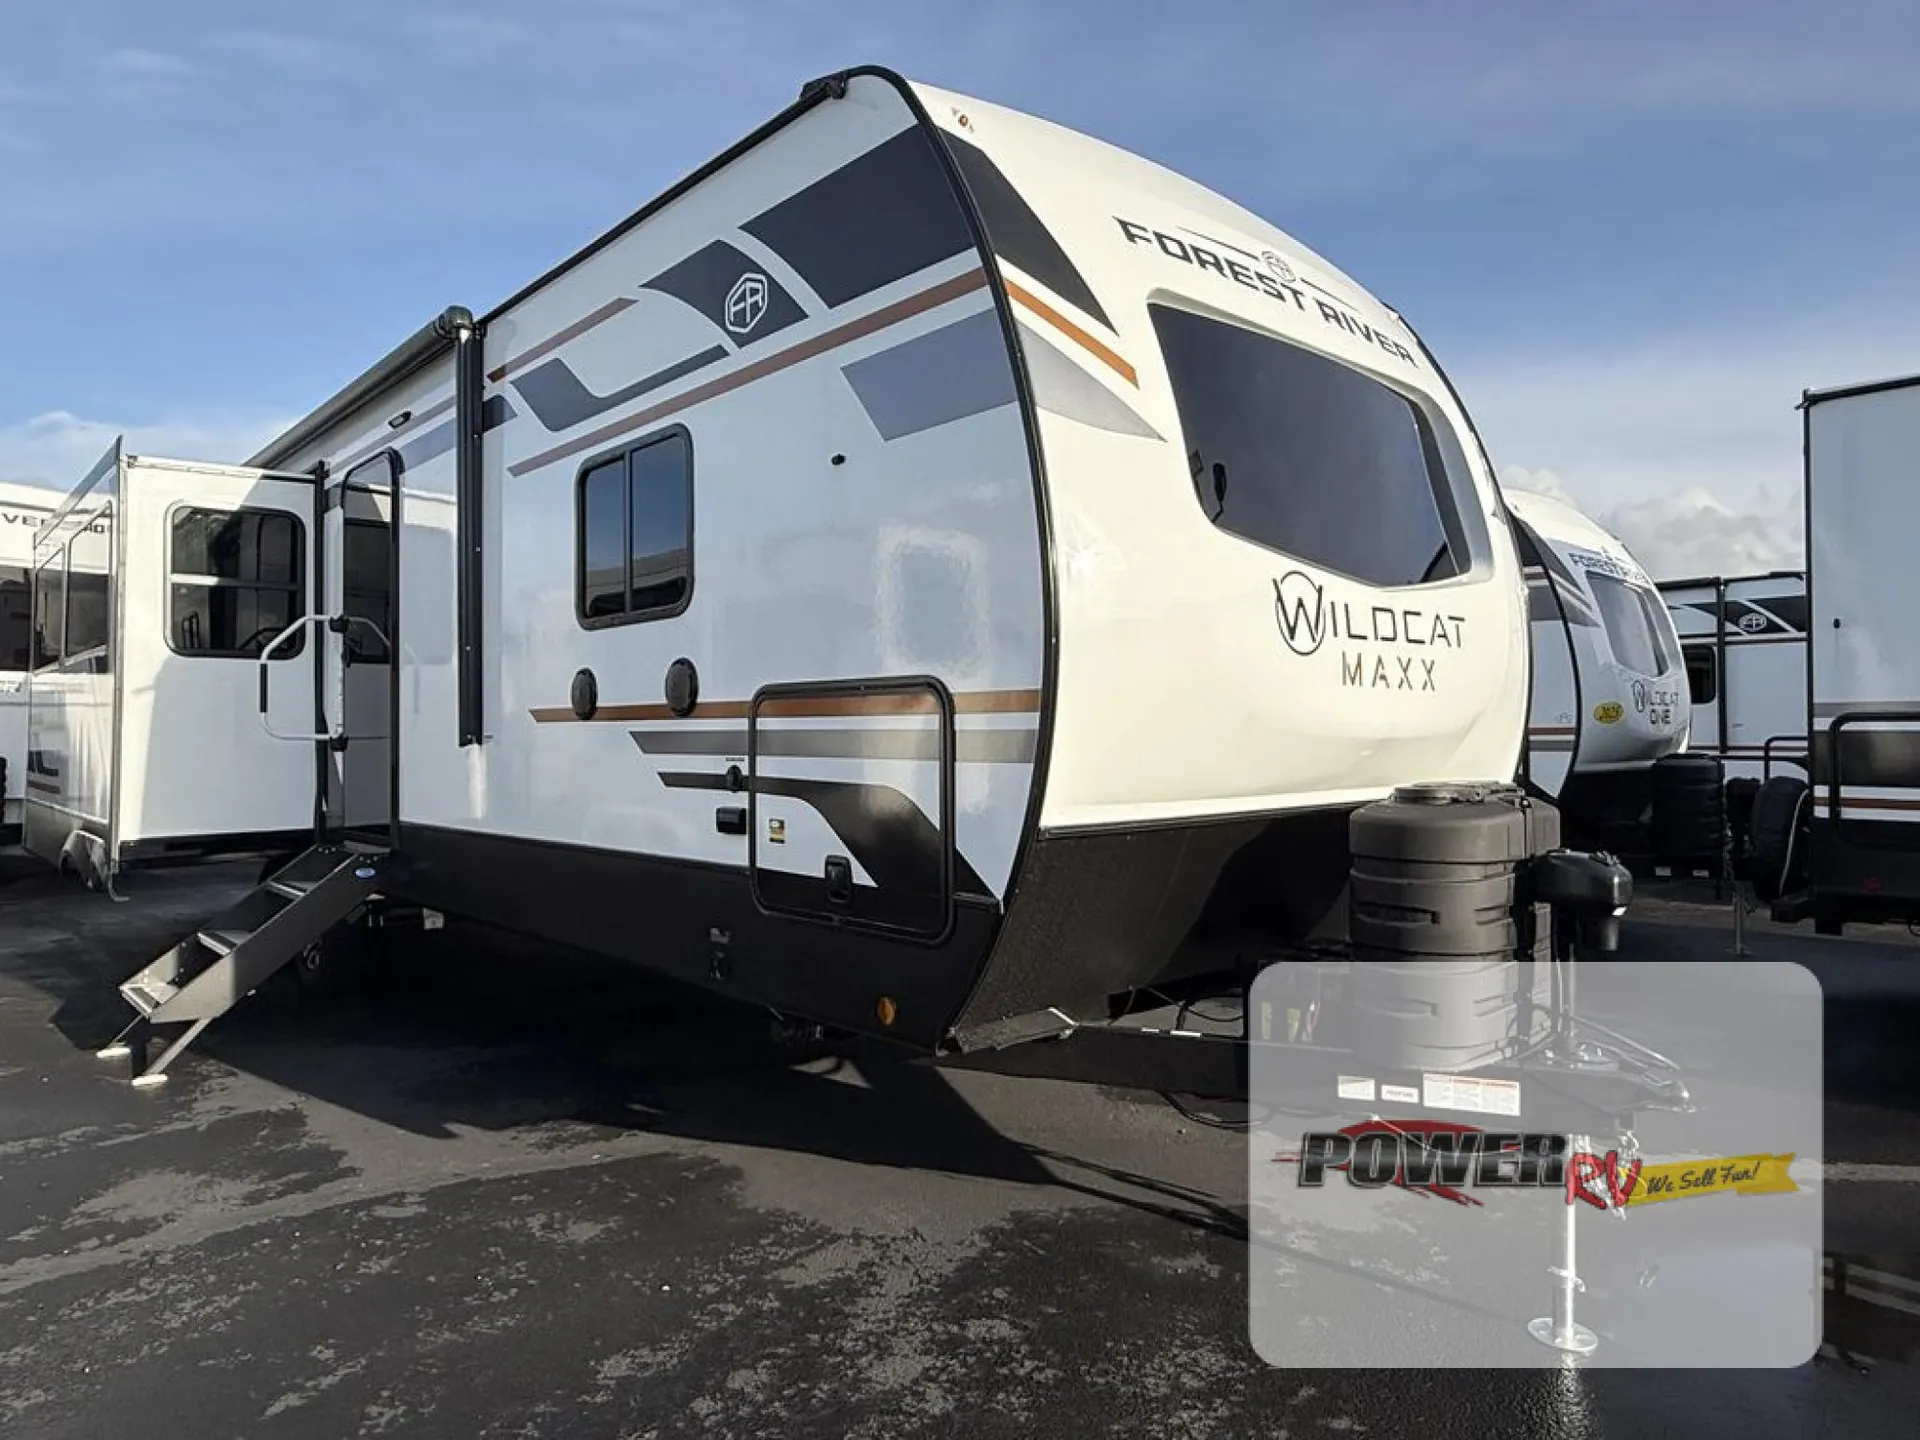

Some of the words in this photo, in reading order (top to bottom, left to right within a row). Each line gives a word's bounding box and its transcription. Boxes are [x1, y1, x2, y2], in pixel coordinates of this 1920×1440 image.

[1111, 214, 1306, 312] FOREST
[1315, 298, 1421, 368] RIVER
[1272, 570, 1466, 657] WILDCAT
[1341, 650, 1436, 692] MAXX
